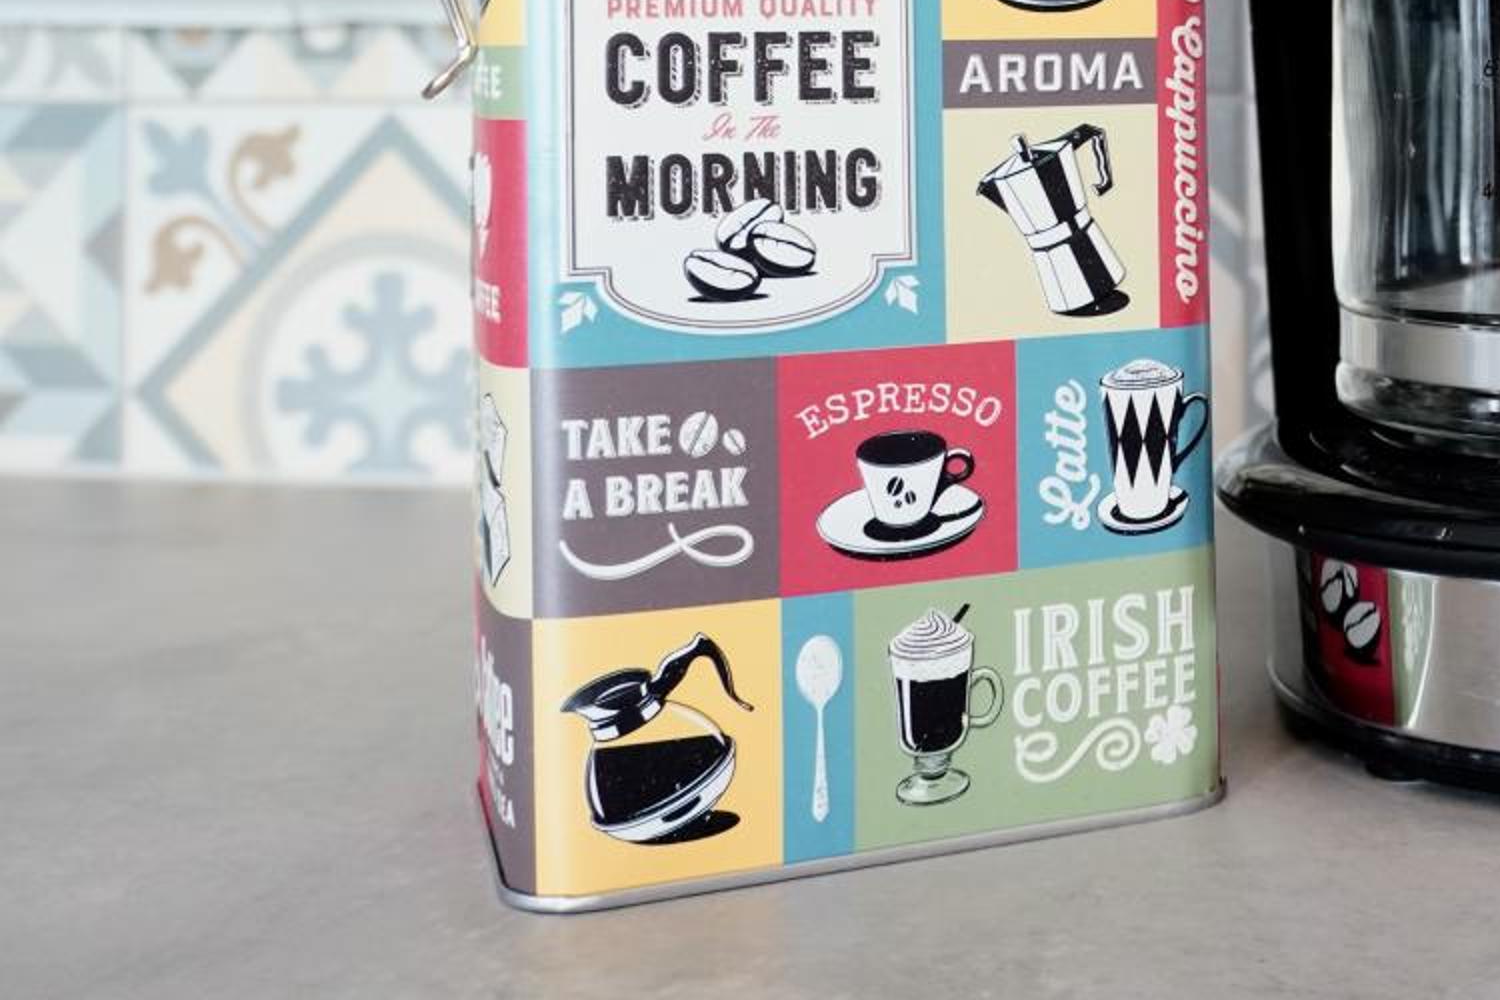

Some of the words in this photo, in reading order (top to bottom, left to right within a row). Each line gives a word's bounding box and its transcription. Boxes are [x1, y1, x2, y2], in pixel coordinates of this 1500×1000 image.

[605, 30, 881, 108] COFFEE
[958, 52, 1144, 94] AROMA
[605, 147, 881, 221] MORNING
[1165, 15, 1204, 304] Cappuccino
[560, 413, 673, 461] TAKE
[794, 380, 1004, 440] ESPRESSO
[1039, 377, 1101, 531] Latte
[561, 478, 594, 521] A
[605, 465, 750, 517] BREAK
[1012, 584, 1196, 677] IRISH
[1011, 653, 1197, 729] COFFEE
